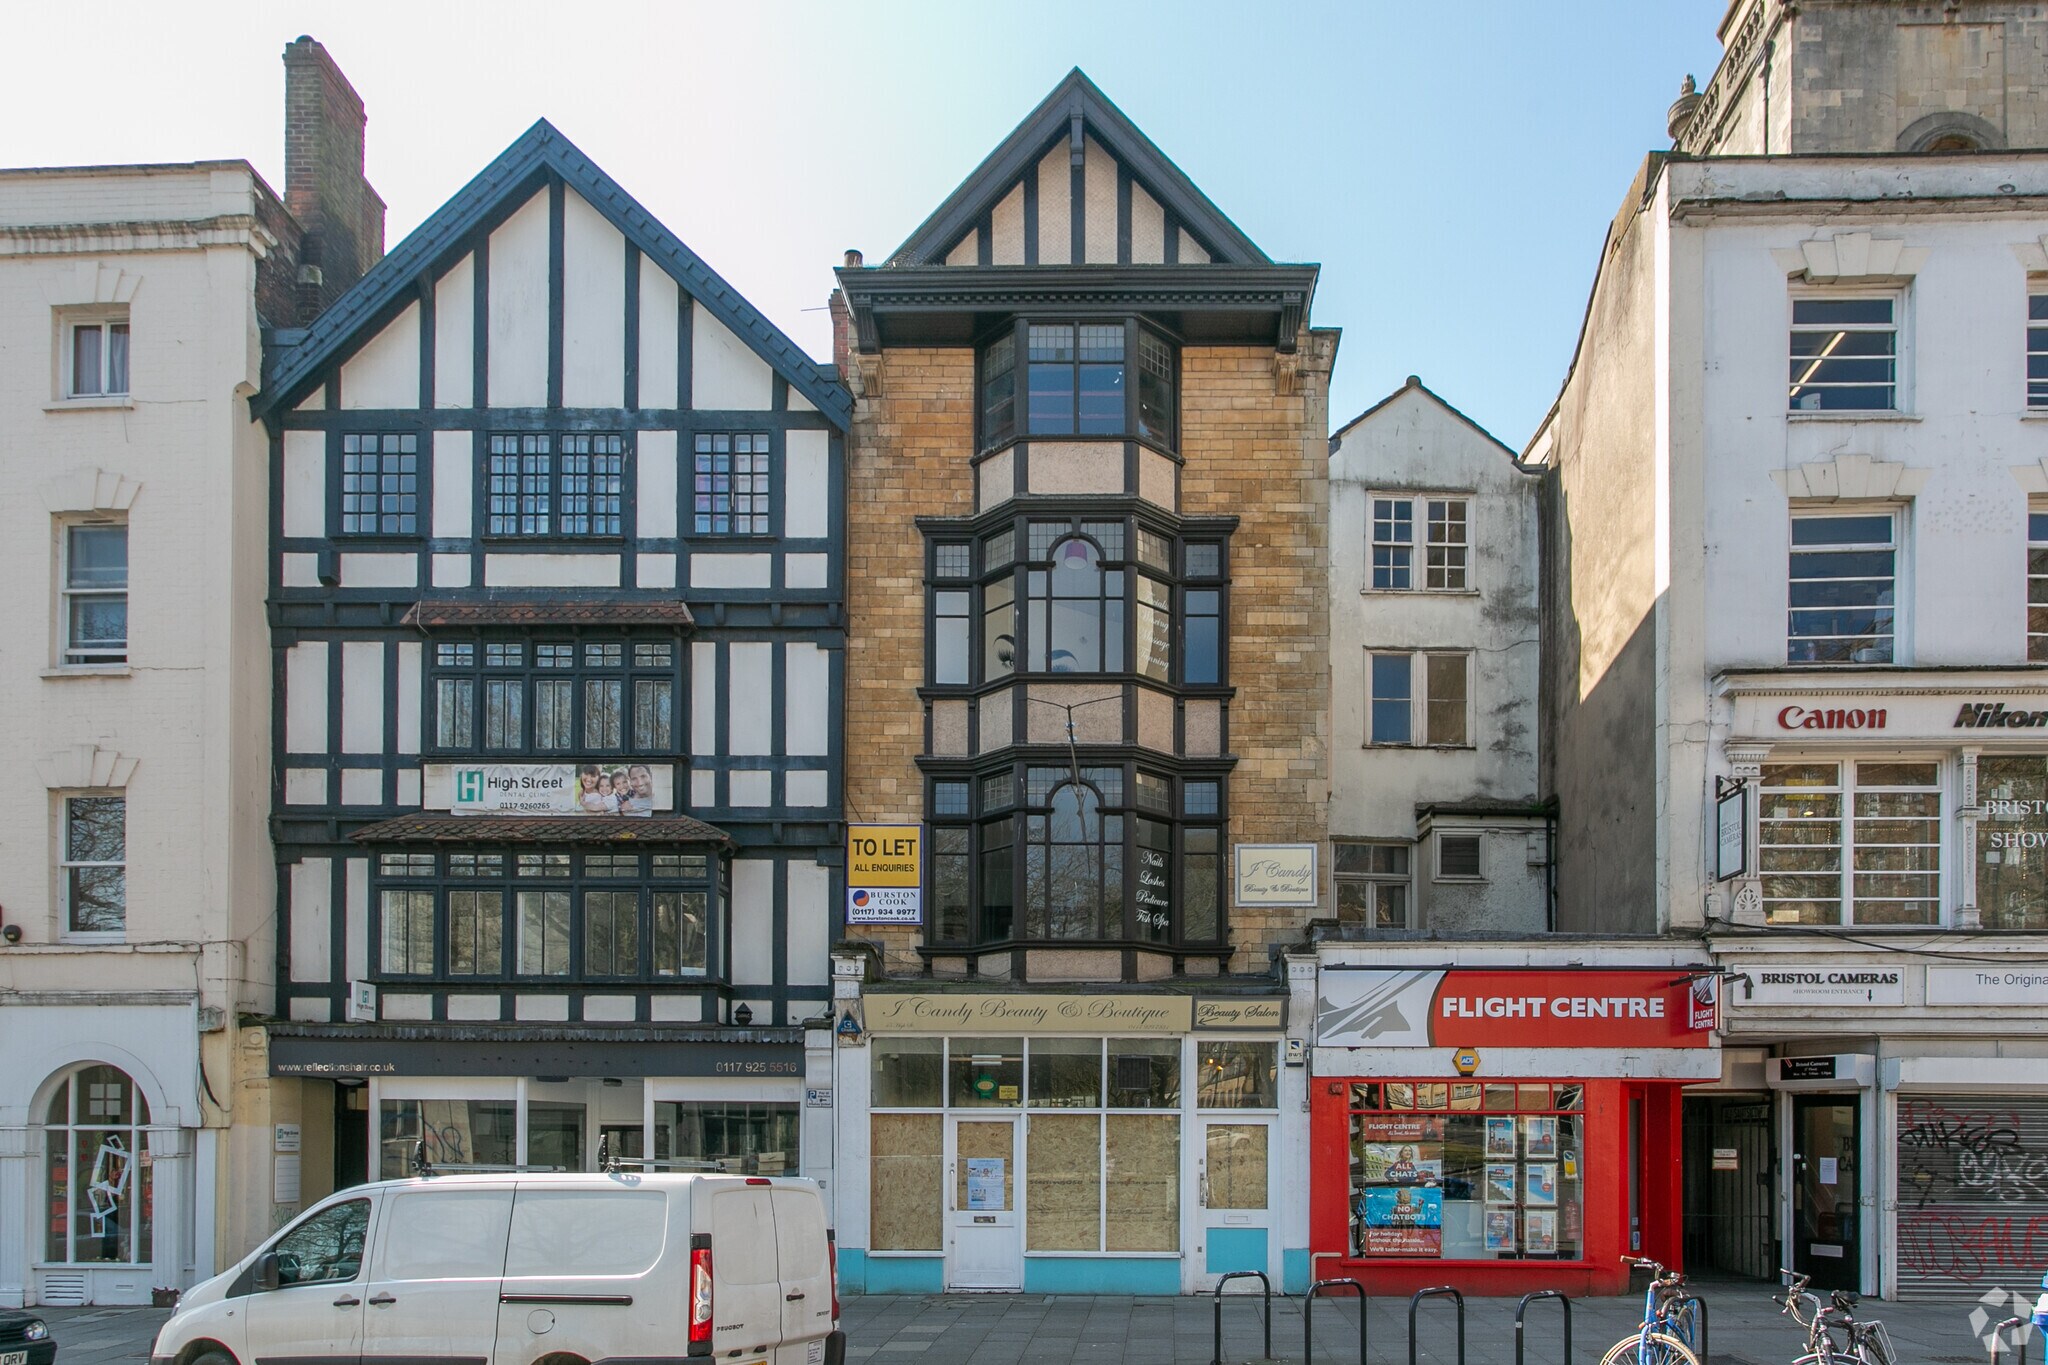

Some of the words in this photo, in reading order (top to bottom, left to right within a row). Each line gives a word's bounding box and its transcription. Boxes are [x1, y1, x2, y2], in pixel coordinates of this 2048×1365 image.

[1778, 706, 1887, 729] Canon
[1954, 703, 2048, 728] Nikon
[488, 777, 518, 791] High
[521, 777, 563, 788] Street
[1984, 801, 2048, 815] BRIST
[853, 839, 877, 856] TO
[883, 839, 916, 856] LET
[1141, 850, 1163, 867] Nails
[872, 864, 915, 872] ENQUIRIES
[1262, 860, 1312, 884] Candy
[1140, 870, 1165, 887] Lashes
[1244, 884, 1268, 895] Beauty
[1281, 884, 1309, 894] Boutique
[1136, 890, 1168, 907] Pedicure
[1136, 908, 1151, 923] Fish
[1153, 913, 1169, 929] Spa
[1761, 973, 1825, 984] BRISTOL
[1828, 973, 1898, 984] CAMERAS
[1976, 974, 1999, 985] The
[910, 997, 972, 1025] Candy
[980, 998, 1047, 1024] Beauty
[1057, 1000, 1082, 1017] &
[1087, 999, 1169, 1024] Boutique
[1198, 1004, 1240, 1022] Beauty
[1244, 1005, 1279, 1018] Salon
[1443, 998, 1546, 1018] FLIGHT
[1550, 998, 1665, 1018] CENTRE
[1695, 1009, 1713, 1020] FLIGHT
[1695, 1019, 1713, 1029] CENTRE
[278, 1063, 395, 1072] www.reflectionshair.co.uk
[716, 1062, 742, 1072] 0117
[745, 1062, 766, 1072] 925
[769, 1062, 797, 1072] 5516
